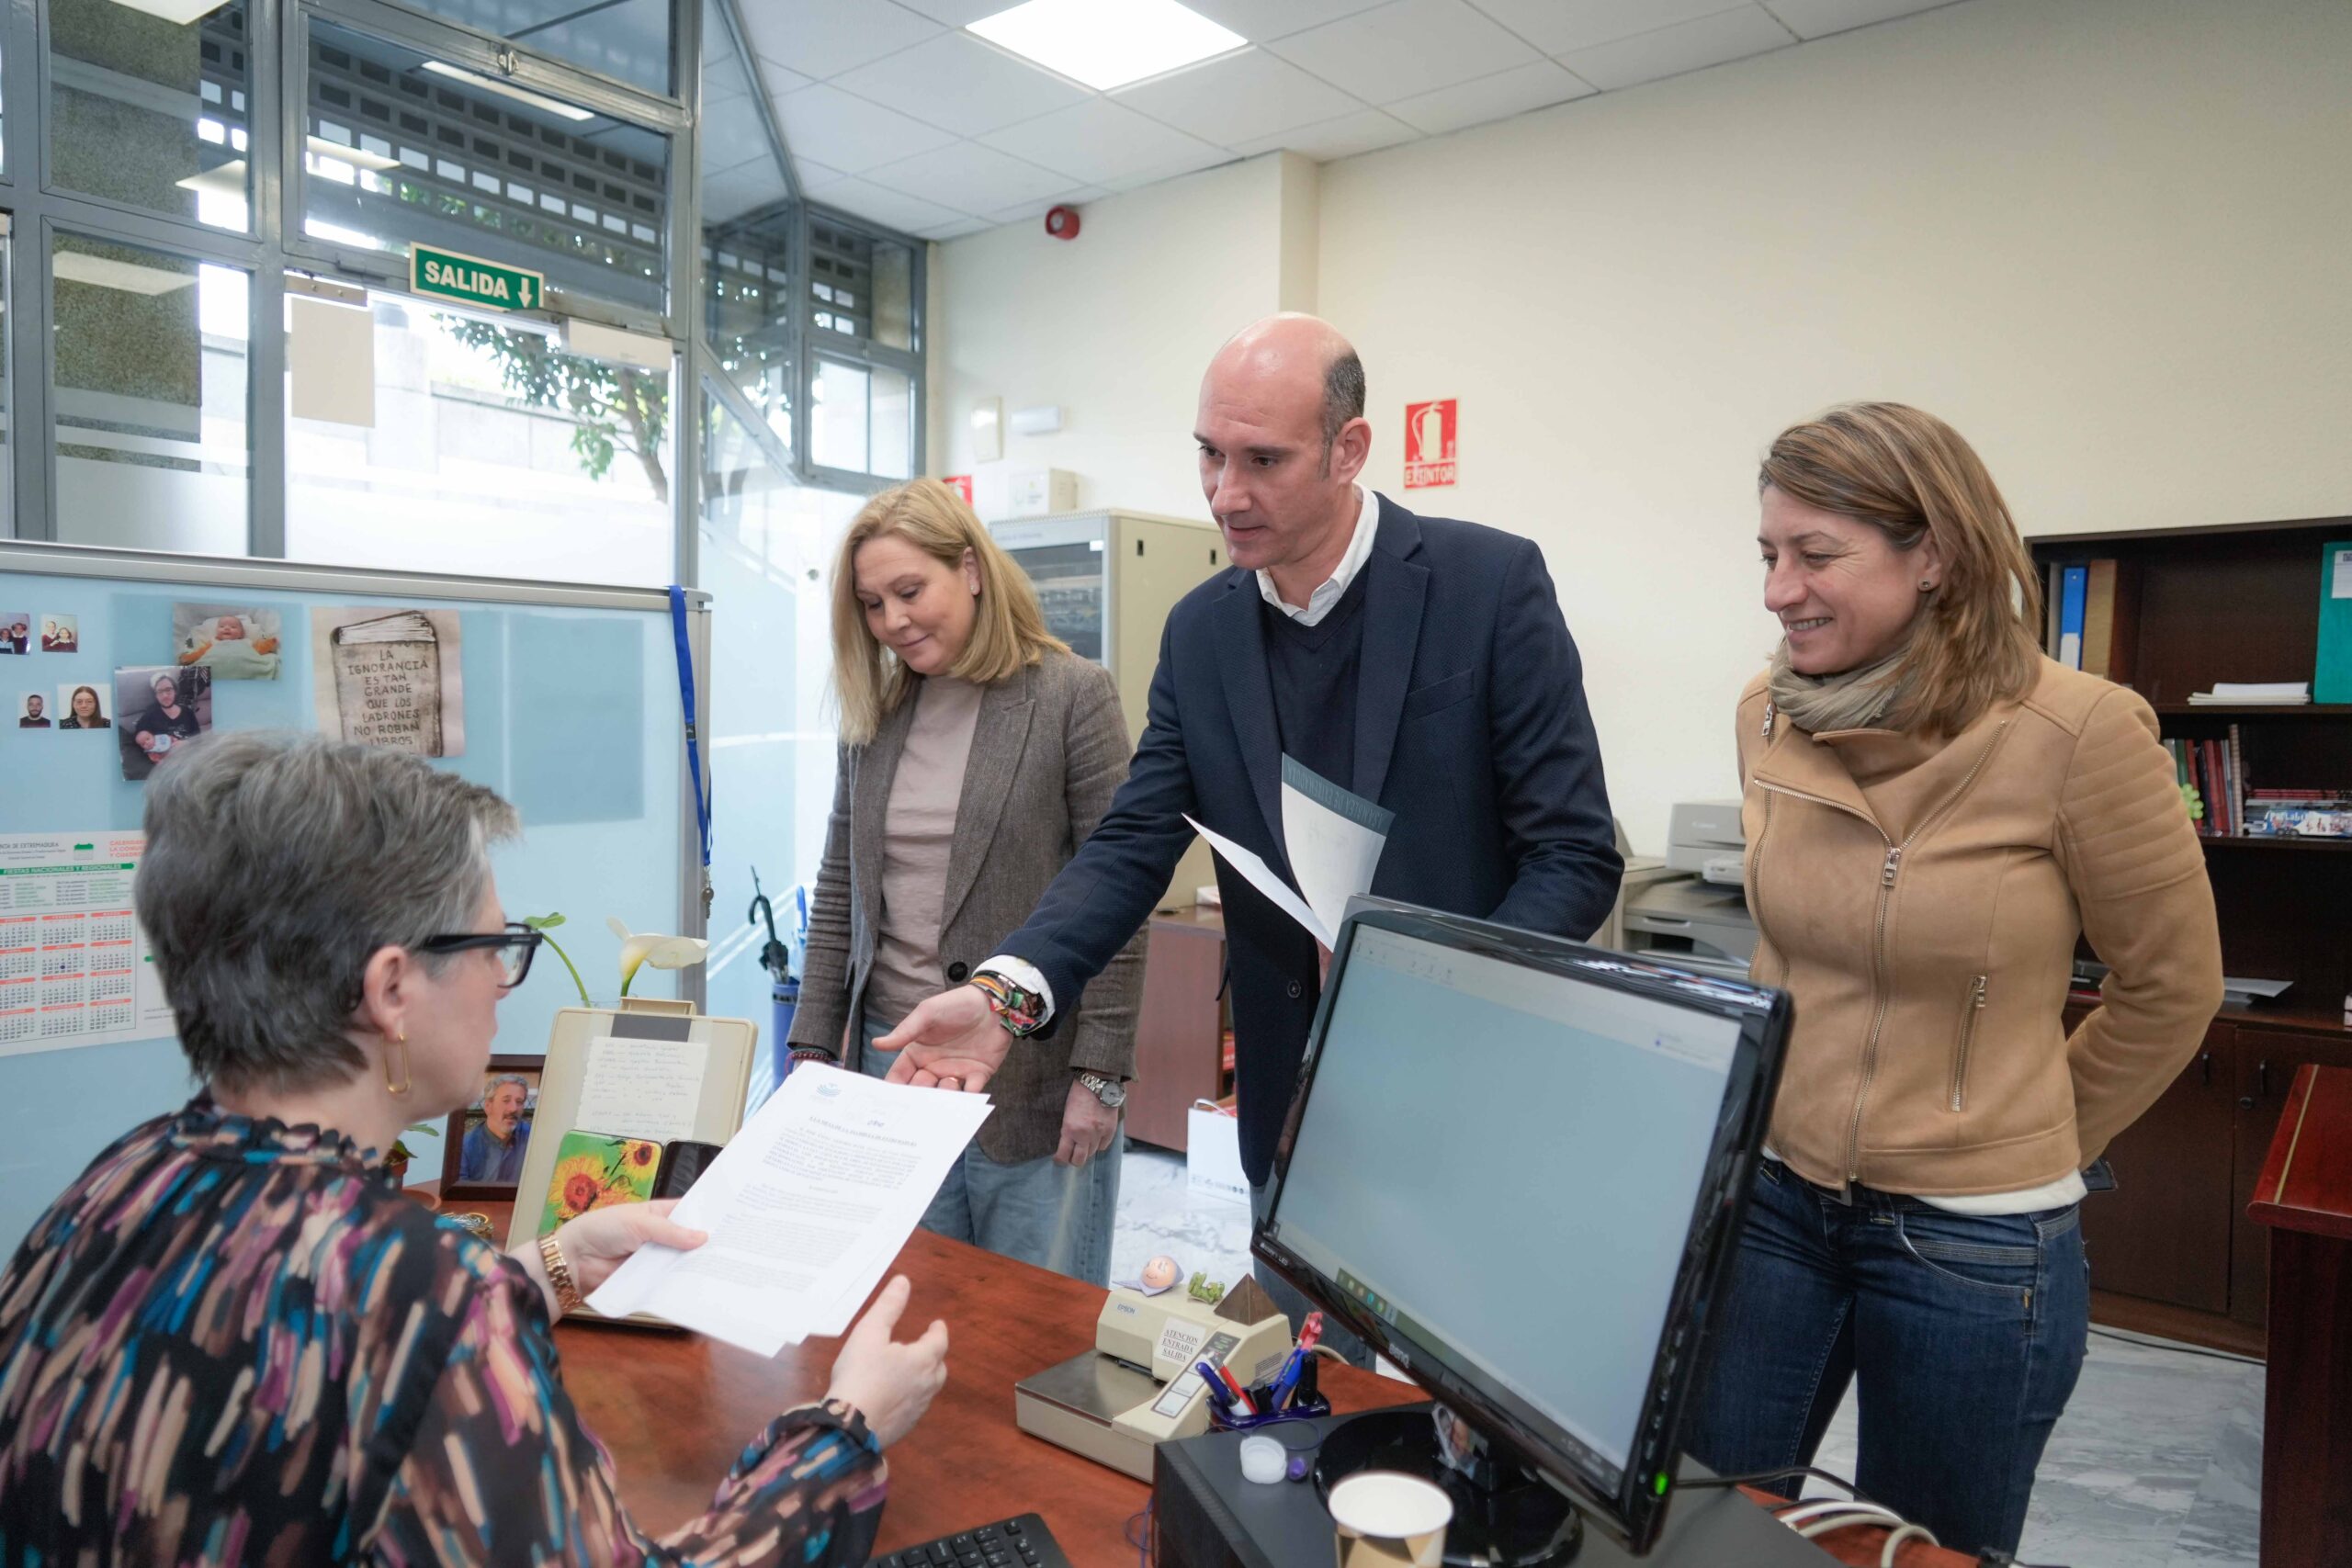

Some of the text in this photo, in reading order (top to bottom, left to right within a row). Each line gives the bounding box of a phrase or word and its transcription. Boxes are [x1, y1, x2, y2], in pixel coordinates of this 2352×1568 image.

[424, 260, 510, 299] SALIDA
[379, 649, 394, 661] LA
[348, 660, 428, 675] IGNORANCIA
[365, 674, 407, 685] ES TAN
[365, 683, 412, 696] GRANDE
[368, 698, 412, 710] QUE LOS
[362, 708, 419, 723] LADRONES
[355, 721, 420, 735] NO ROBAN
[1117, 1303, 1136, 1314] EPSON
[1162, 1337, 1193, 1353] ENTRADA
[1162, 1348, 1186, 1361] SALIDA
